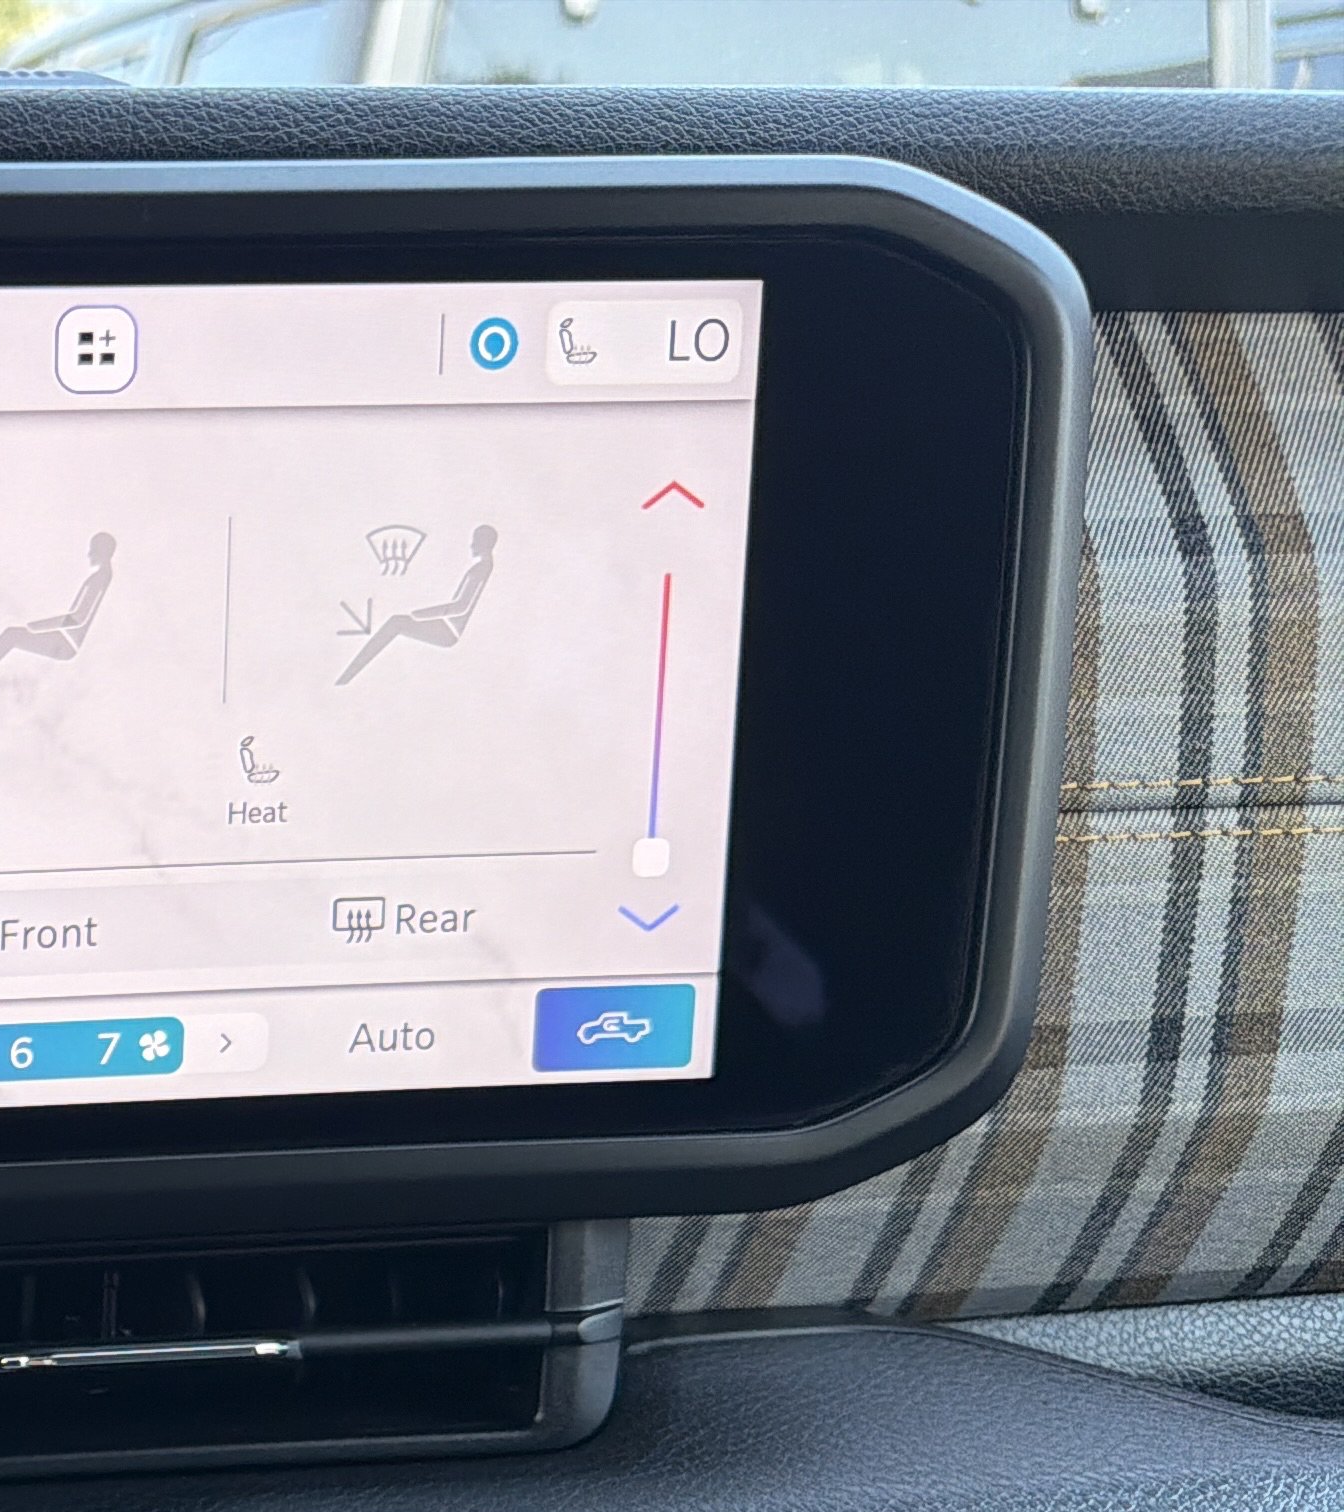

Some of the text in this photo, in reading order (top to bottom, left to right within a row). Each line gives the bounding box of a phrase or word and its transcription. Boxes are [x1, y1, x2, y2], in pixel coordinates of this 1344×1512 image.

[667, 318, 730, 363] LO
[227, 802, 288, 825] Heat
[394, 904, 477, 935] Rear
[10, 1037, 34, 1069] 6
[97, 1033, 121, 1065] 7
[349, 1023, 435, 1053] Auto
